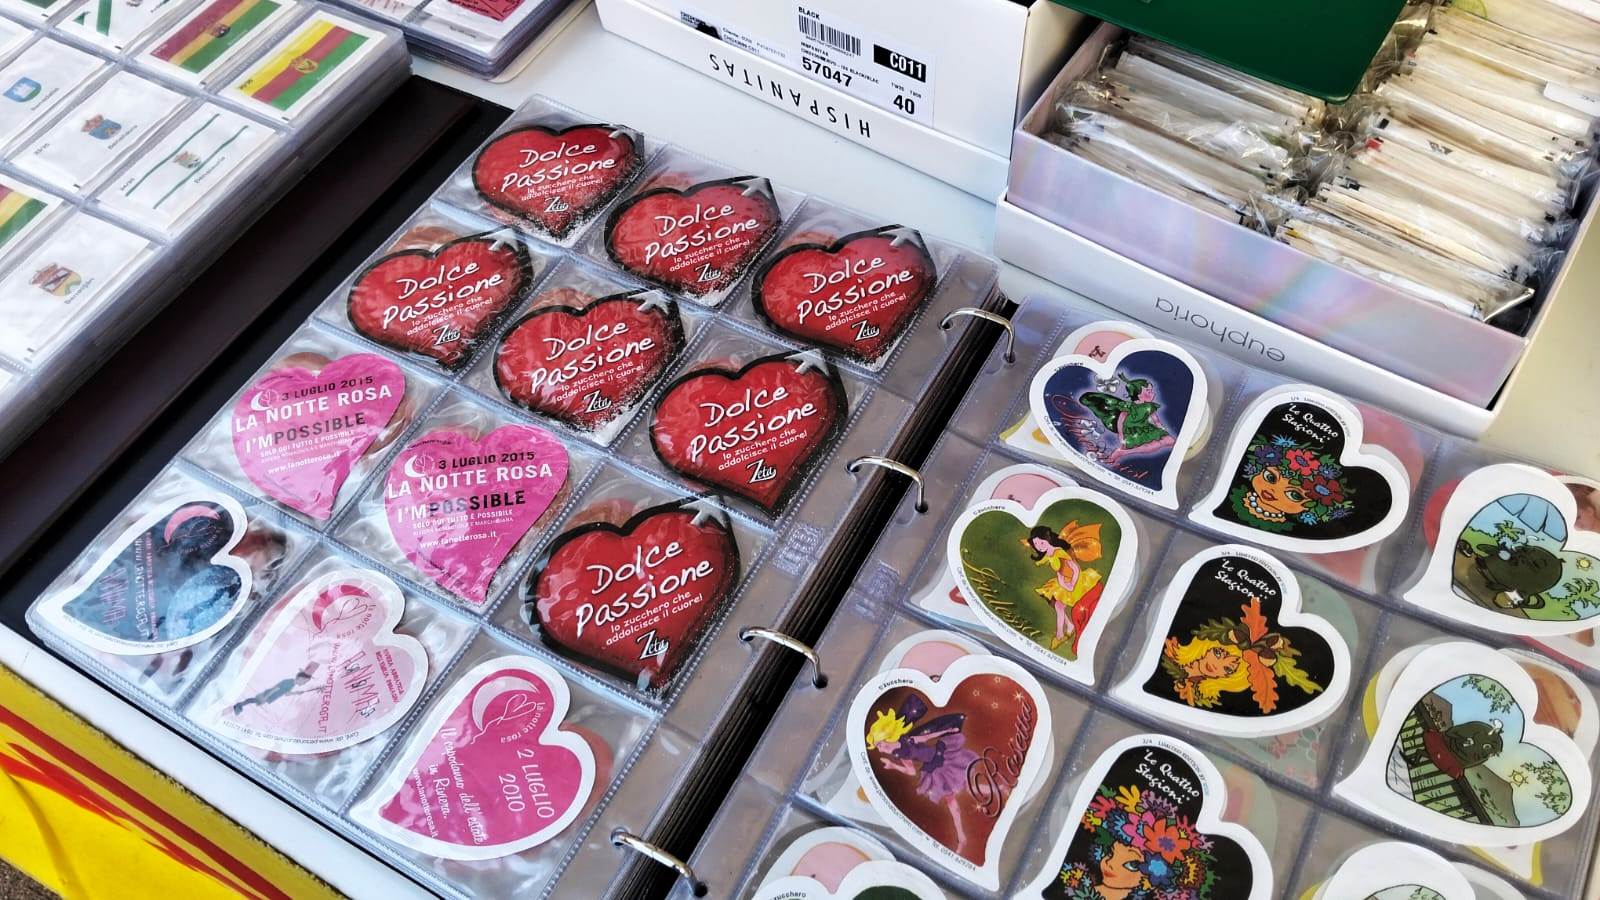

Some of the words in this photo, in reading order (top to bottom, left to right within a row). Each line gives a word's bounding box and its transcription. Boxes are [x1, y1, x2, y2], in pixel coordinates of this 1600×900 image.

[798, 6, 820, 20] BLACK
[802, 56, 852, 87] 57047
[889, 52, 923, 79] C011
[709, 53, 871, 138] HISPANITAS
[893, 94, 915, 115] 40
[519, 141, 597, 168] Dolce
[655, 203, 735, 237] Dolce
[396, 262, 480, 300] Dolce
[803, 256, 886, 294] Dolce
[825, 310, 871, 331] addolcisce
[872, 304, 879, 312] il
[880, 293, 908, 309] cuore!
[839, 298, 878, 317] zucchero
[880, 291, 897, 301] che
[543, 322, 629, 361] Dolce
[1155, 297, 1286, 362] euphoria
[281, 392, 289, 401] 3
[294, 382, 336, 399] LUGLIO
[341, 376, 374, 389] 2015
[235, 414, 258, 433] LA
[266, 396, 329, 424] NOTTE
[337, 384, 392, 407] ROSA
[700, 386, 790, 428] Dolce
[1302, 412, 1339, 438] Quattro
[438, 460, 447, 470] 3
[452, 454, 497, 468] LUGLIO
[501, 451, 535, 463] 2015
[718, 446, 769, 471] addolcisce
[770, 440, 777, 451] il
[779, 430, 808, 448] cuore!
[722, 452, 732, 460] lo
[734, 436, 778, 456] zucchero
[779, 427, 797, 440] che
[388, 481, 412, 499] LA
[420, 469, 487, 493] NOTTE
[496, 463, 553, 482] ROSA
[586, 541, 684, 595] Dolce
[1236, 568, 1277, 596] Quattro
[606, 614, 661, 646] addolcisce
[662, 608, 669, 617] il
[671, 593, 703, 615] cuore!
[610, 623, 620, 633] lo
[623, 601, 670, 627] zucchero
[672, 590, 691, 604] che
[524, 714, 543, 735] notte
[536, 702, 546, 713] la
[439, 728, 457, 738] Il
[500, 732, 522, 744] rosa
[428, 764, 439, 775] in
[441, 745, 464, 791] capodanno
[517, 748, 534, 759] 2
[966, 700, 1033, 818] Rosetta
[499, 773, 526, 813] 2010
[522, 764, 555, 819] LUGLIO
[1159, 763, 1200, 798] Quattro
[411, 768, 438, 839] www.lanotterosa.it
